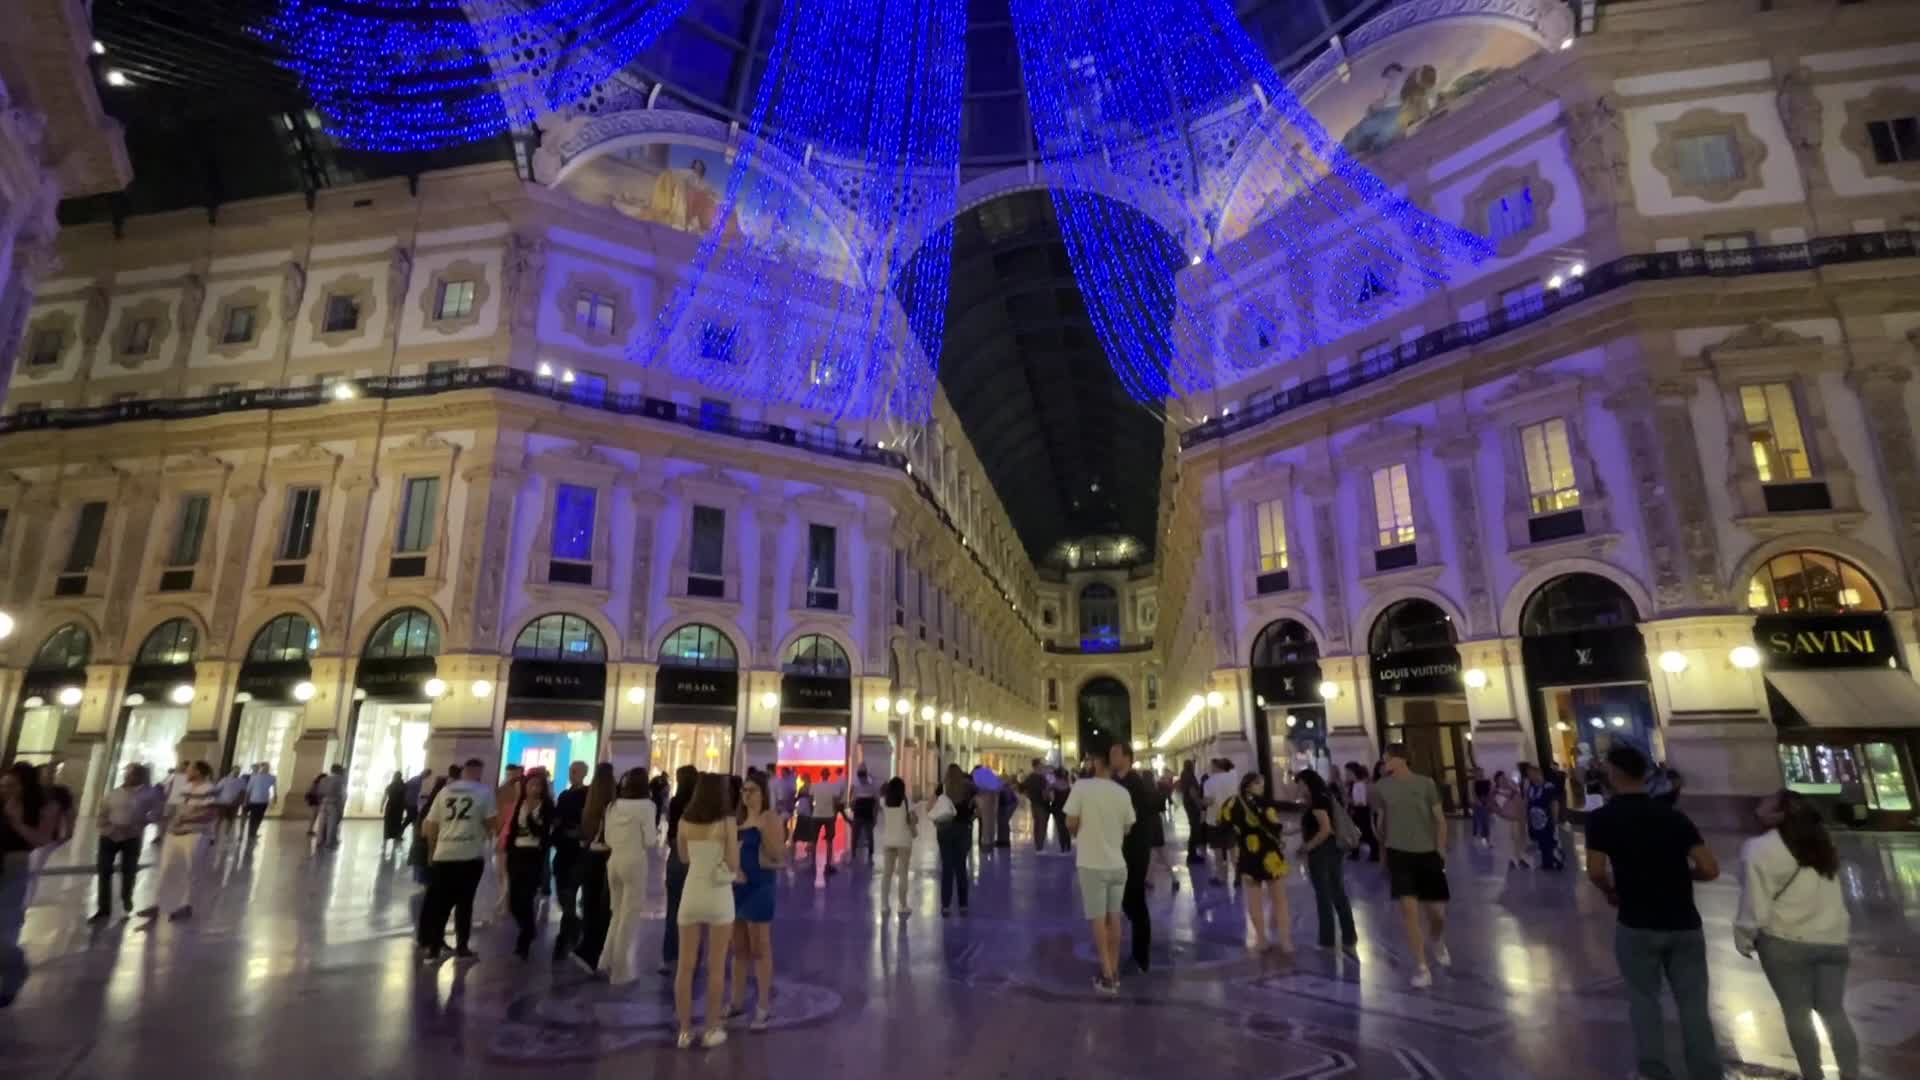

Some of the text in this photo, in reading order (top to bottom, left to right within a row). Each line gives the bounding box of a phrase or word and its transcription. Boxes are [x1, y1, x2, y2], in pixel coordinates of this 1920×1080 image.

[1770, 630, 1875, 654] SAVINI
[536, 675, 581, 686] PRADA
[1380, 664, 1457, 681] LOUIS VUITTON
[678, 682, 717, 693] PRADA
[445, 796, 473, 821] 32
